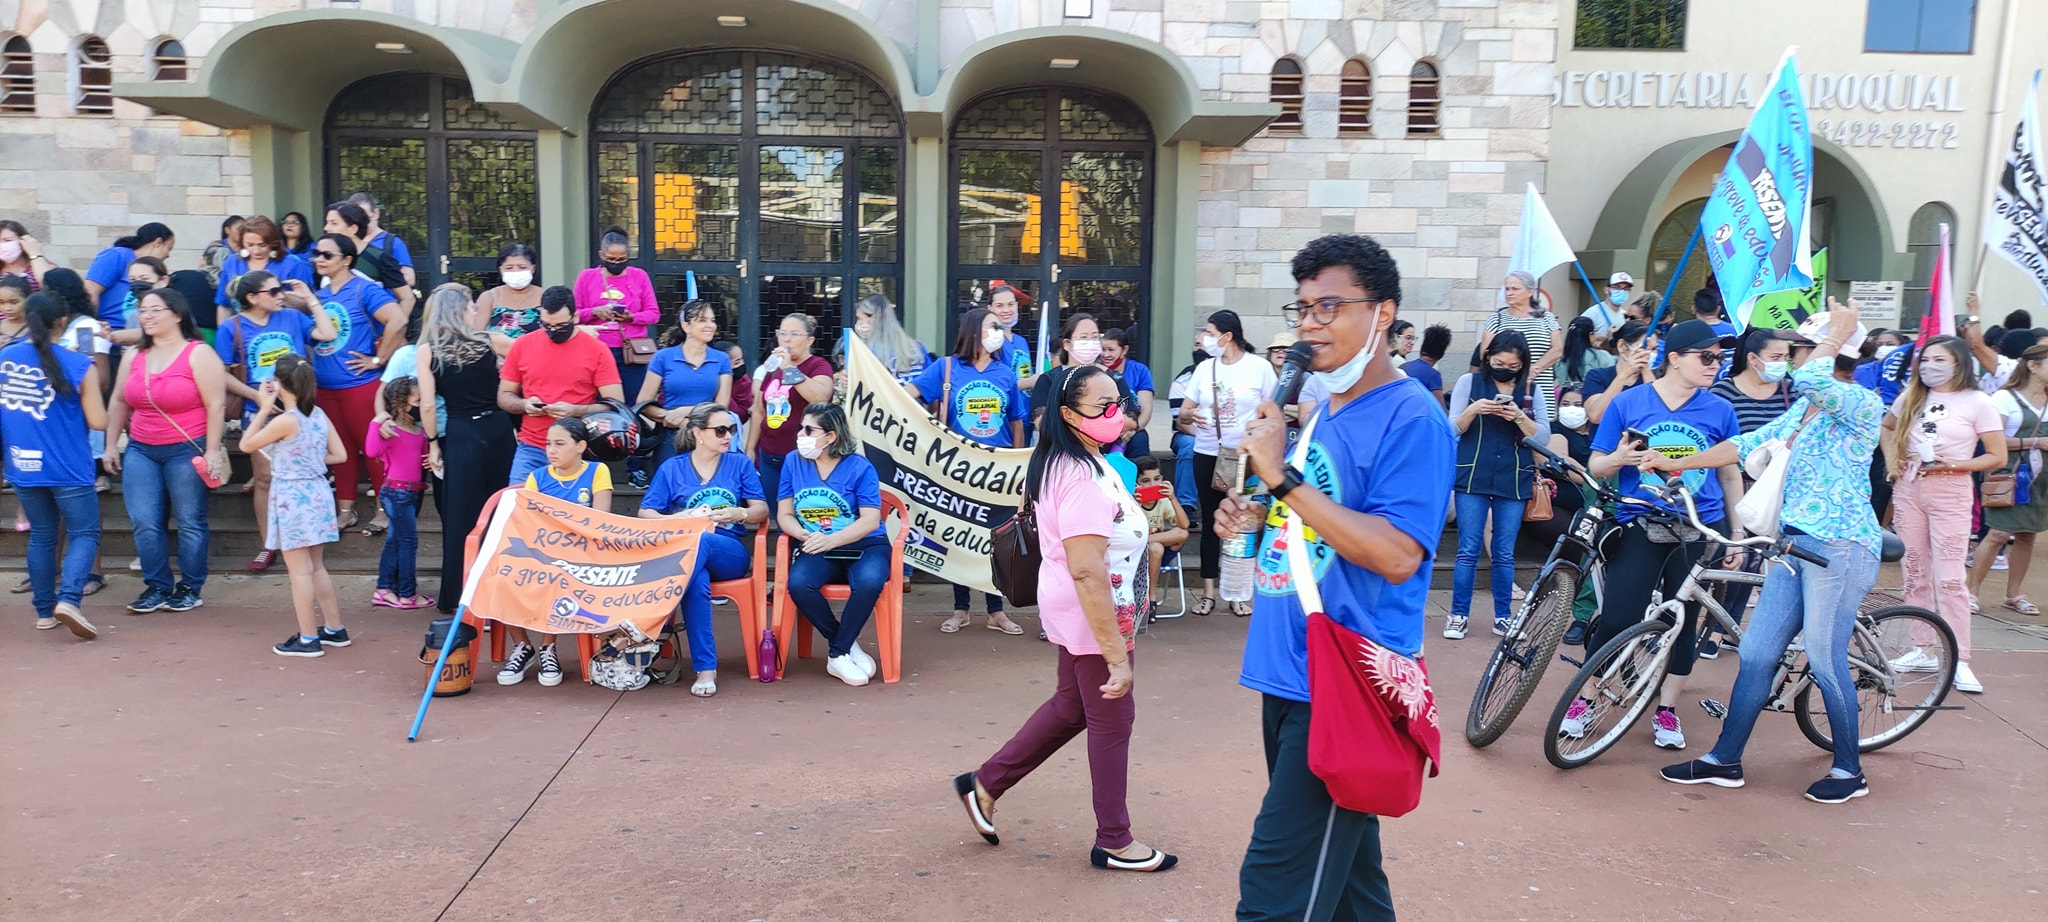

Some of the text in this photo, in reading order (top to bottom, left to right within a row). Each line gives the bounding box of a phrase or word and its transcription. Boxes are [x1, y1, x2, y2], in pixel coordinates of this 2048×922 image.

[1818, 118, 1960, 149] 3422-2272
[850, 380, 918, 456] Maria
[1673, 425, 1685, 433] DA
[819, 489, 828, 497] DA
[893, 467, 992, 524] PRESENTE
[526, 498, 590, 526] ESCOLA
[914, 510, 938, 536] da
[533, 528, 589, 552] ROSA
[904, 544, 945, 567] IMTED
[551, 559, 641, 587] PRESENTE
[514, 568, 569, 589] greve
[573, 588, 597, 605] da
[602, 579, 684, 608] educação
